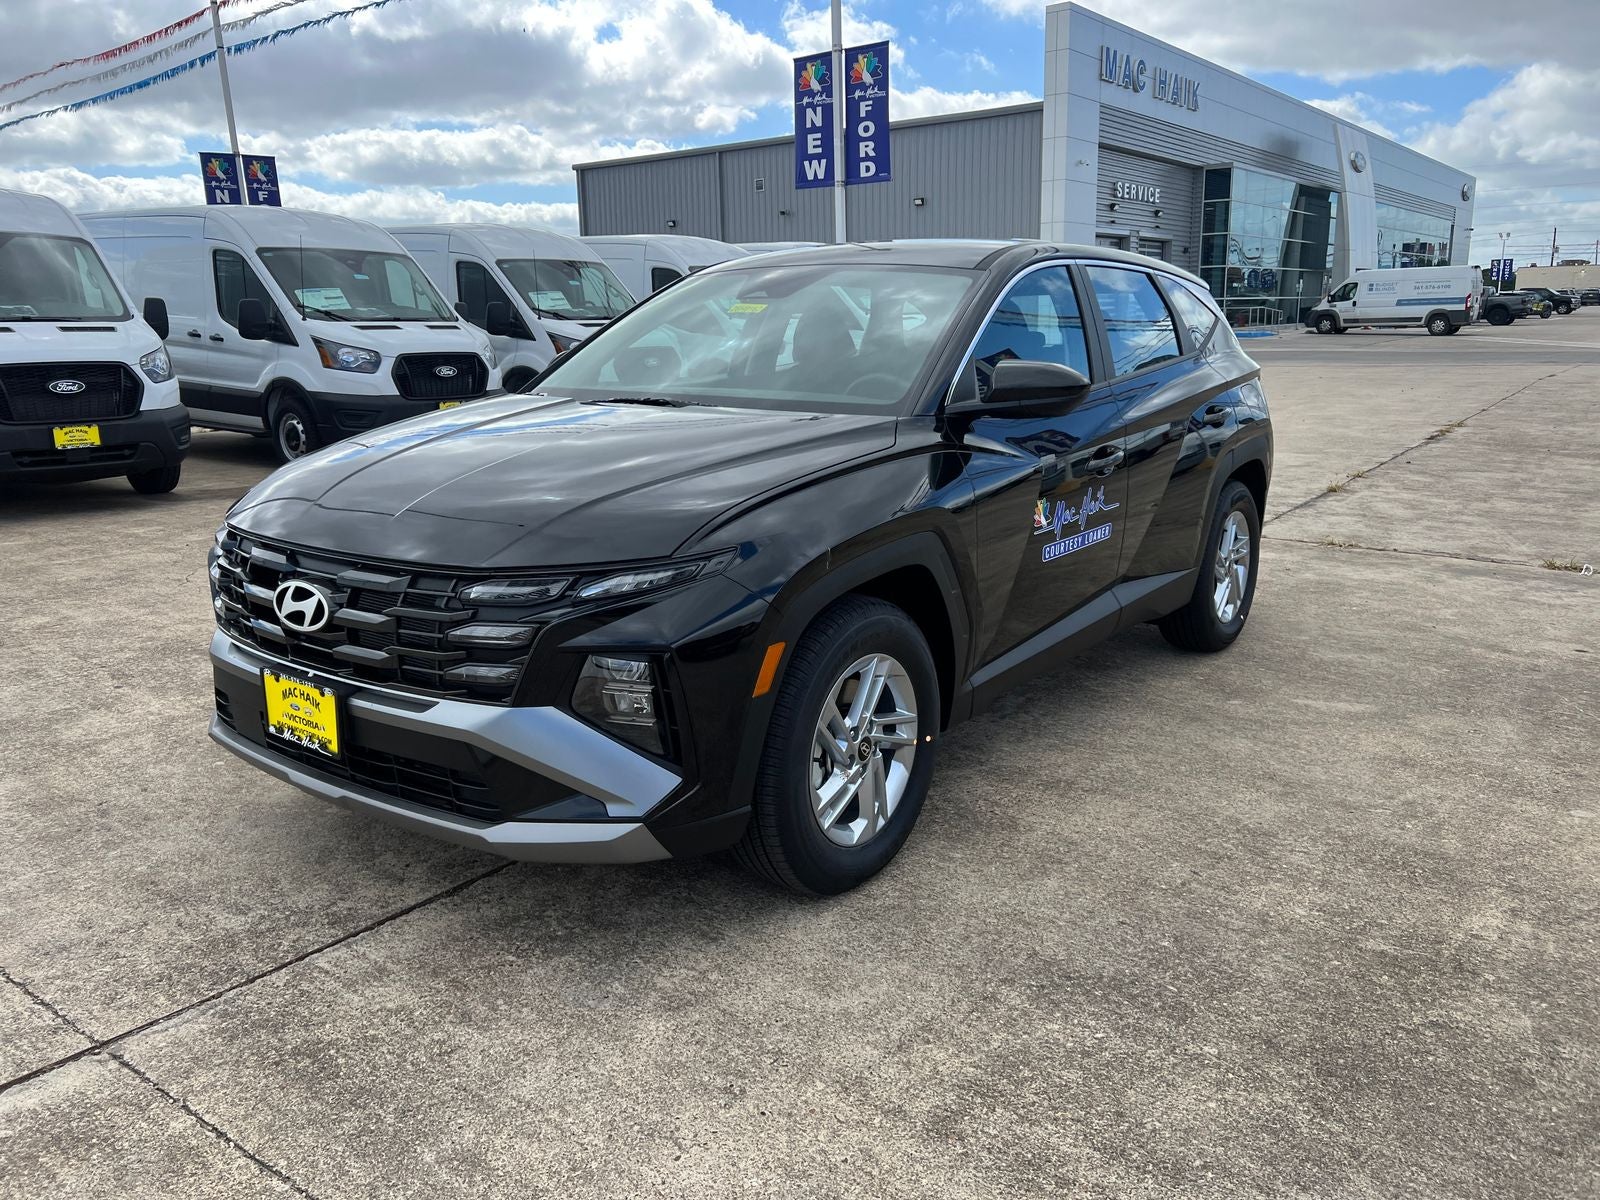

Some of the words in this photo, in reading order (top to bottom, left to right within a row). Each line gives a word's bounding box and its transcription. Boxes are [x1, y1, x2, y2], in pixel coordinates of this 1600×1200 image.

[1101, 44, 1147, 93] MAC
[1152, 66, 1201, 112] HAIK
[803, 107, 827, 181] NEW
[857, 100, 877, 178] FORD
[1116, 181, 1162, 204] SERVICE
[1045, 534, 1083, 559] COURTESY
[1084, 526, 1110, 544] LOANER
[281, 687, 299, 702] MAC
[299, 689, 322, 713] HAIK
[282, 728, 301, 743] Mac
[288, 713, 321, 732] VICTORIA
